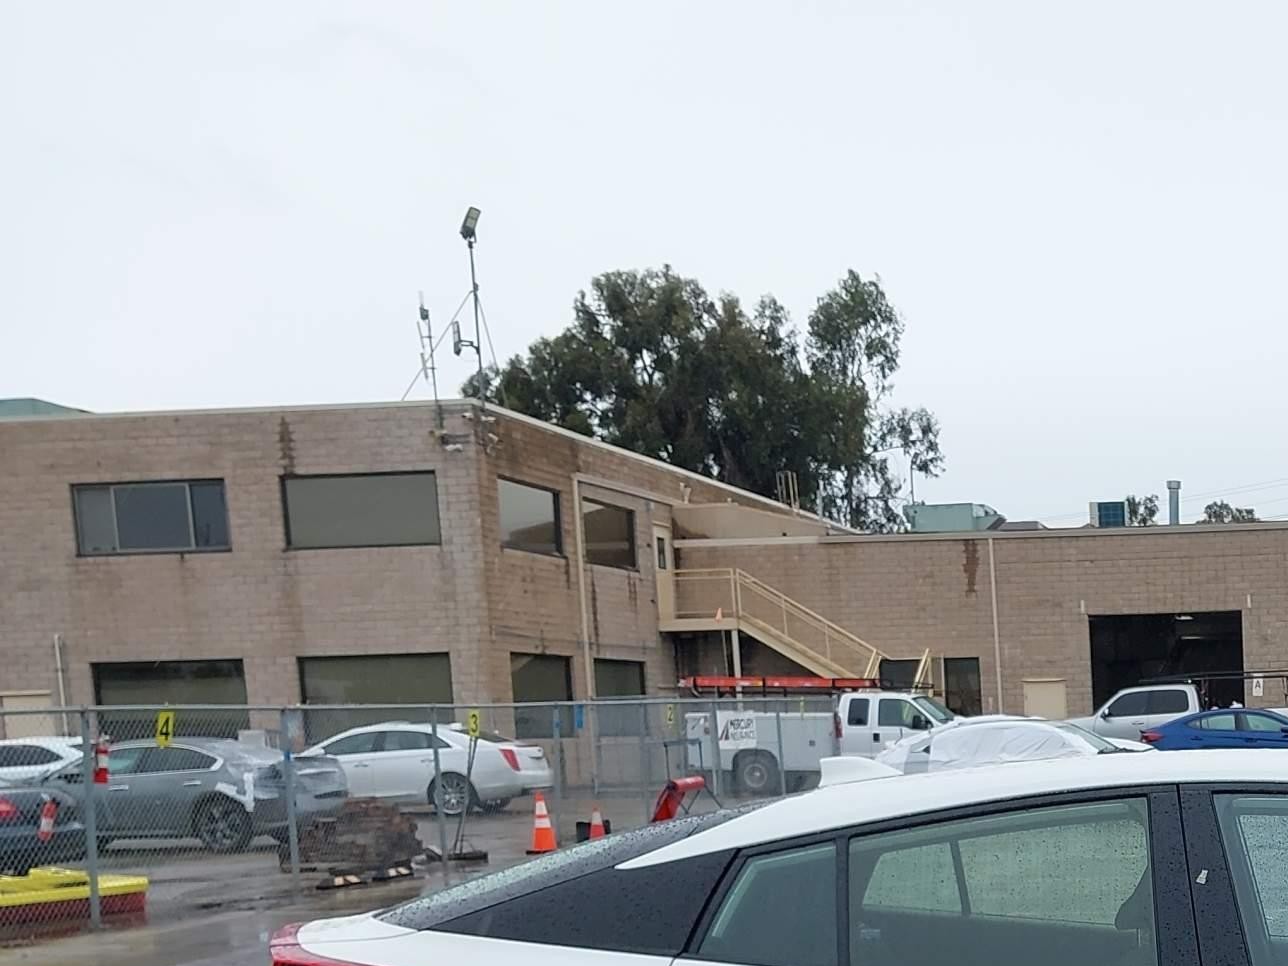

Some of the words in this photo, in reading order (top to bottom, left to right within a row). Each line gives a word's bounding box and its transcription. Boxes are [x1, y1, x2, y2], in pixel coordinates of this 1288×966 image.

[1255, 680, 1261, 688] A
[160, 716, 170, 741] 4
[470, 714, 479, 733] 3
